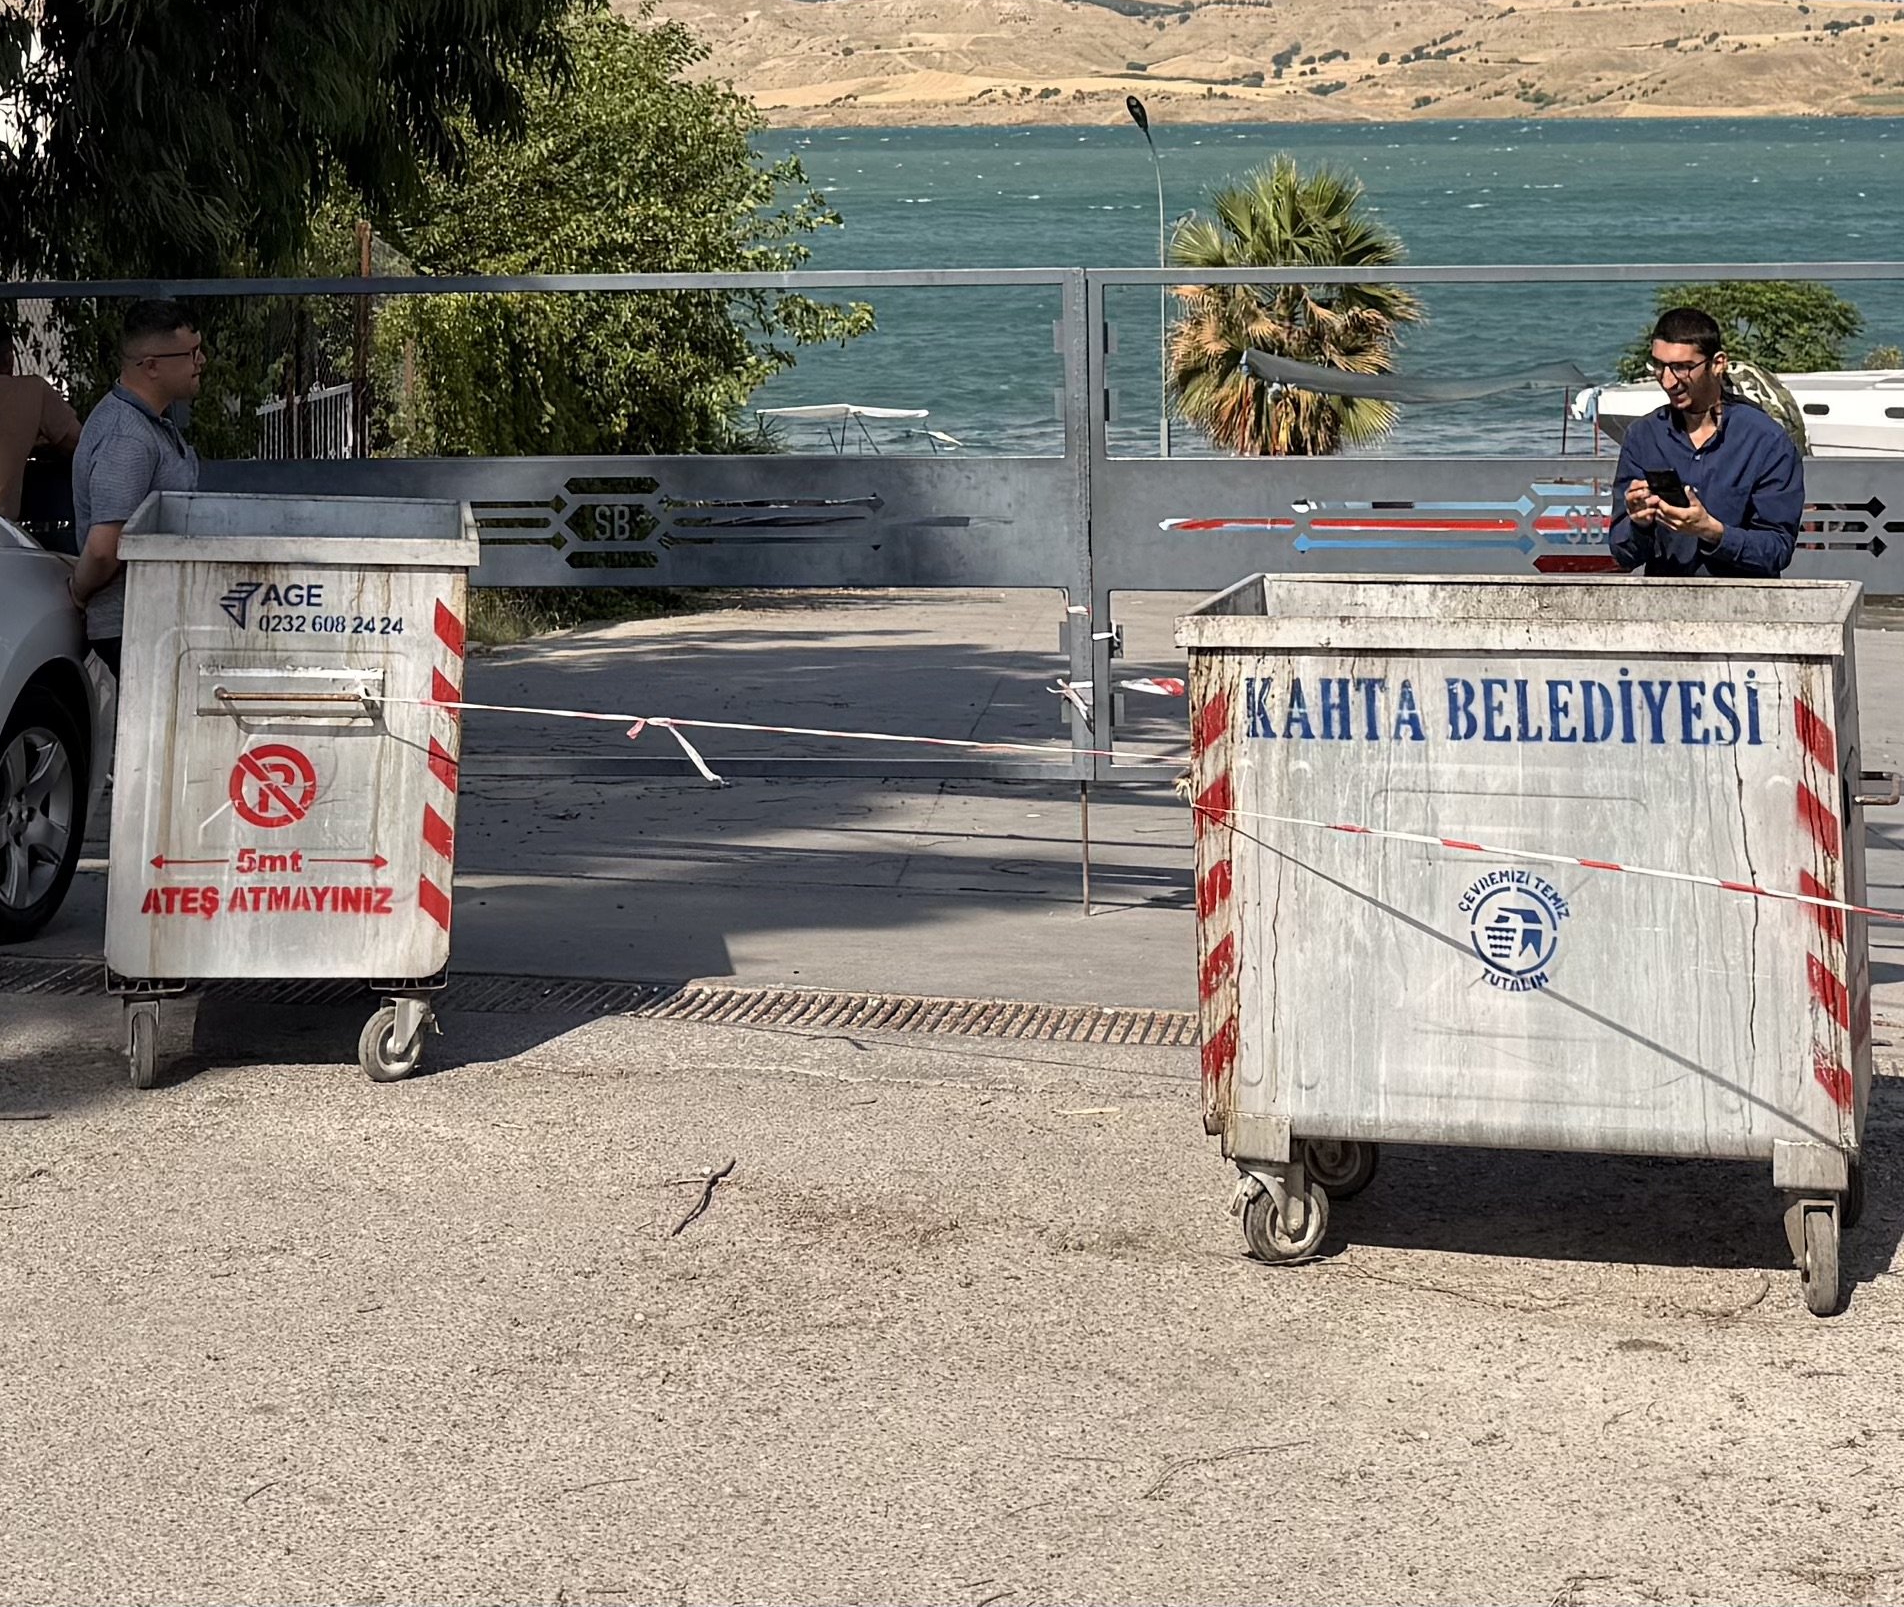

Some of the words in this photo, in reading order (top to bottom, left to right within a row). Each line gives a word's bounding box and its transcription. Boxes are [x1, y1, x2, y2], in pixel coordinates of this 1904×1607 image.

[595, 505, 630, 541] SB
[260, 583, 324, 607] AGE
[259, 614, 306, 633] 0232
[312, 614, 346, 633] 608
[352, 616, 376, 634] 24
[380, 616, 404, 635] 24
[1244, 676, 1429, 741] KAHTA
[1445, 667, 1766, 746] BELEDİYESİ
[235, 848, 303, 873] 5mt
[141, 886, 220, 921] ATEŞ
